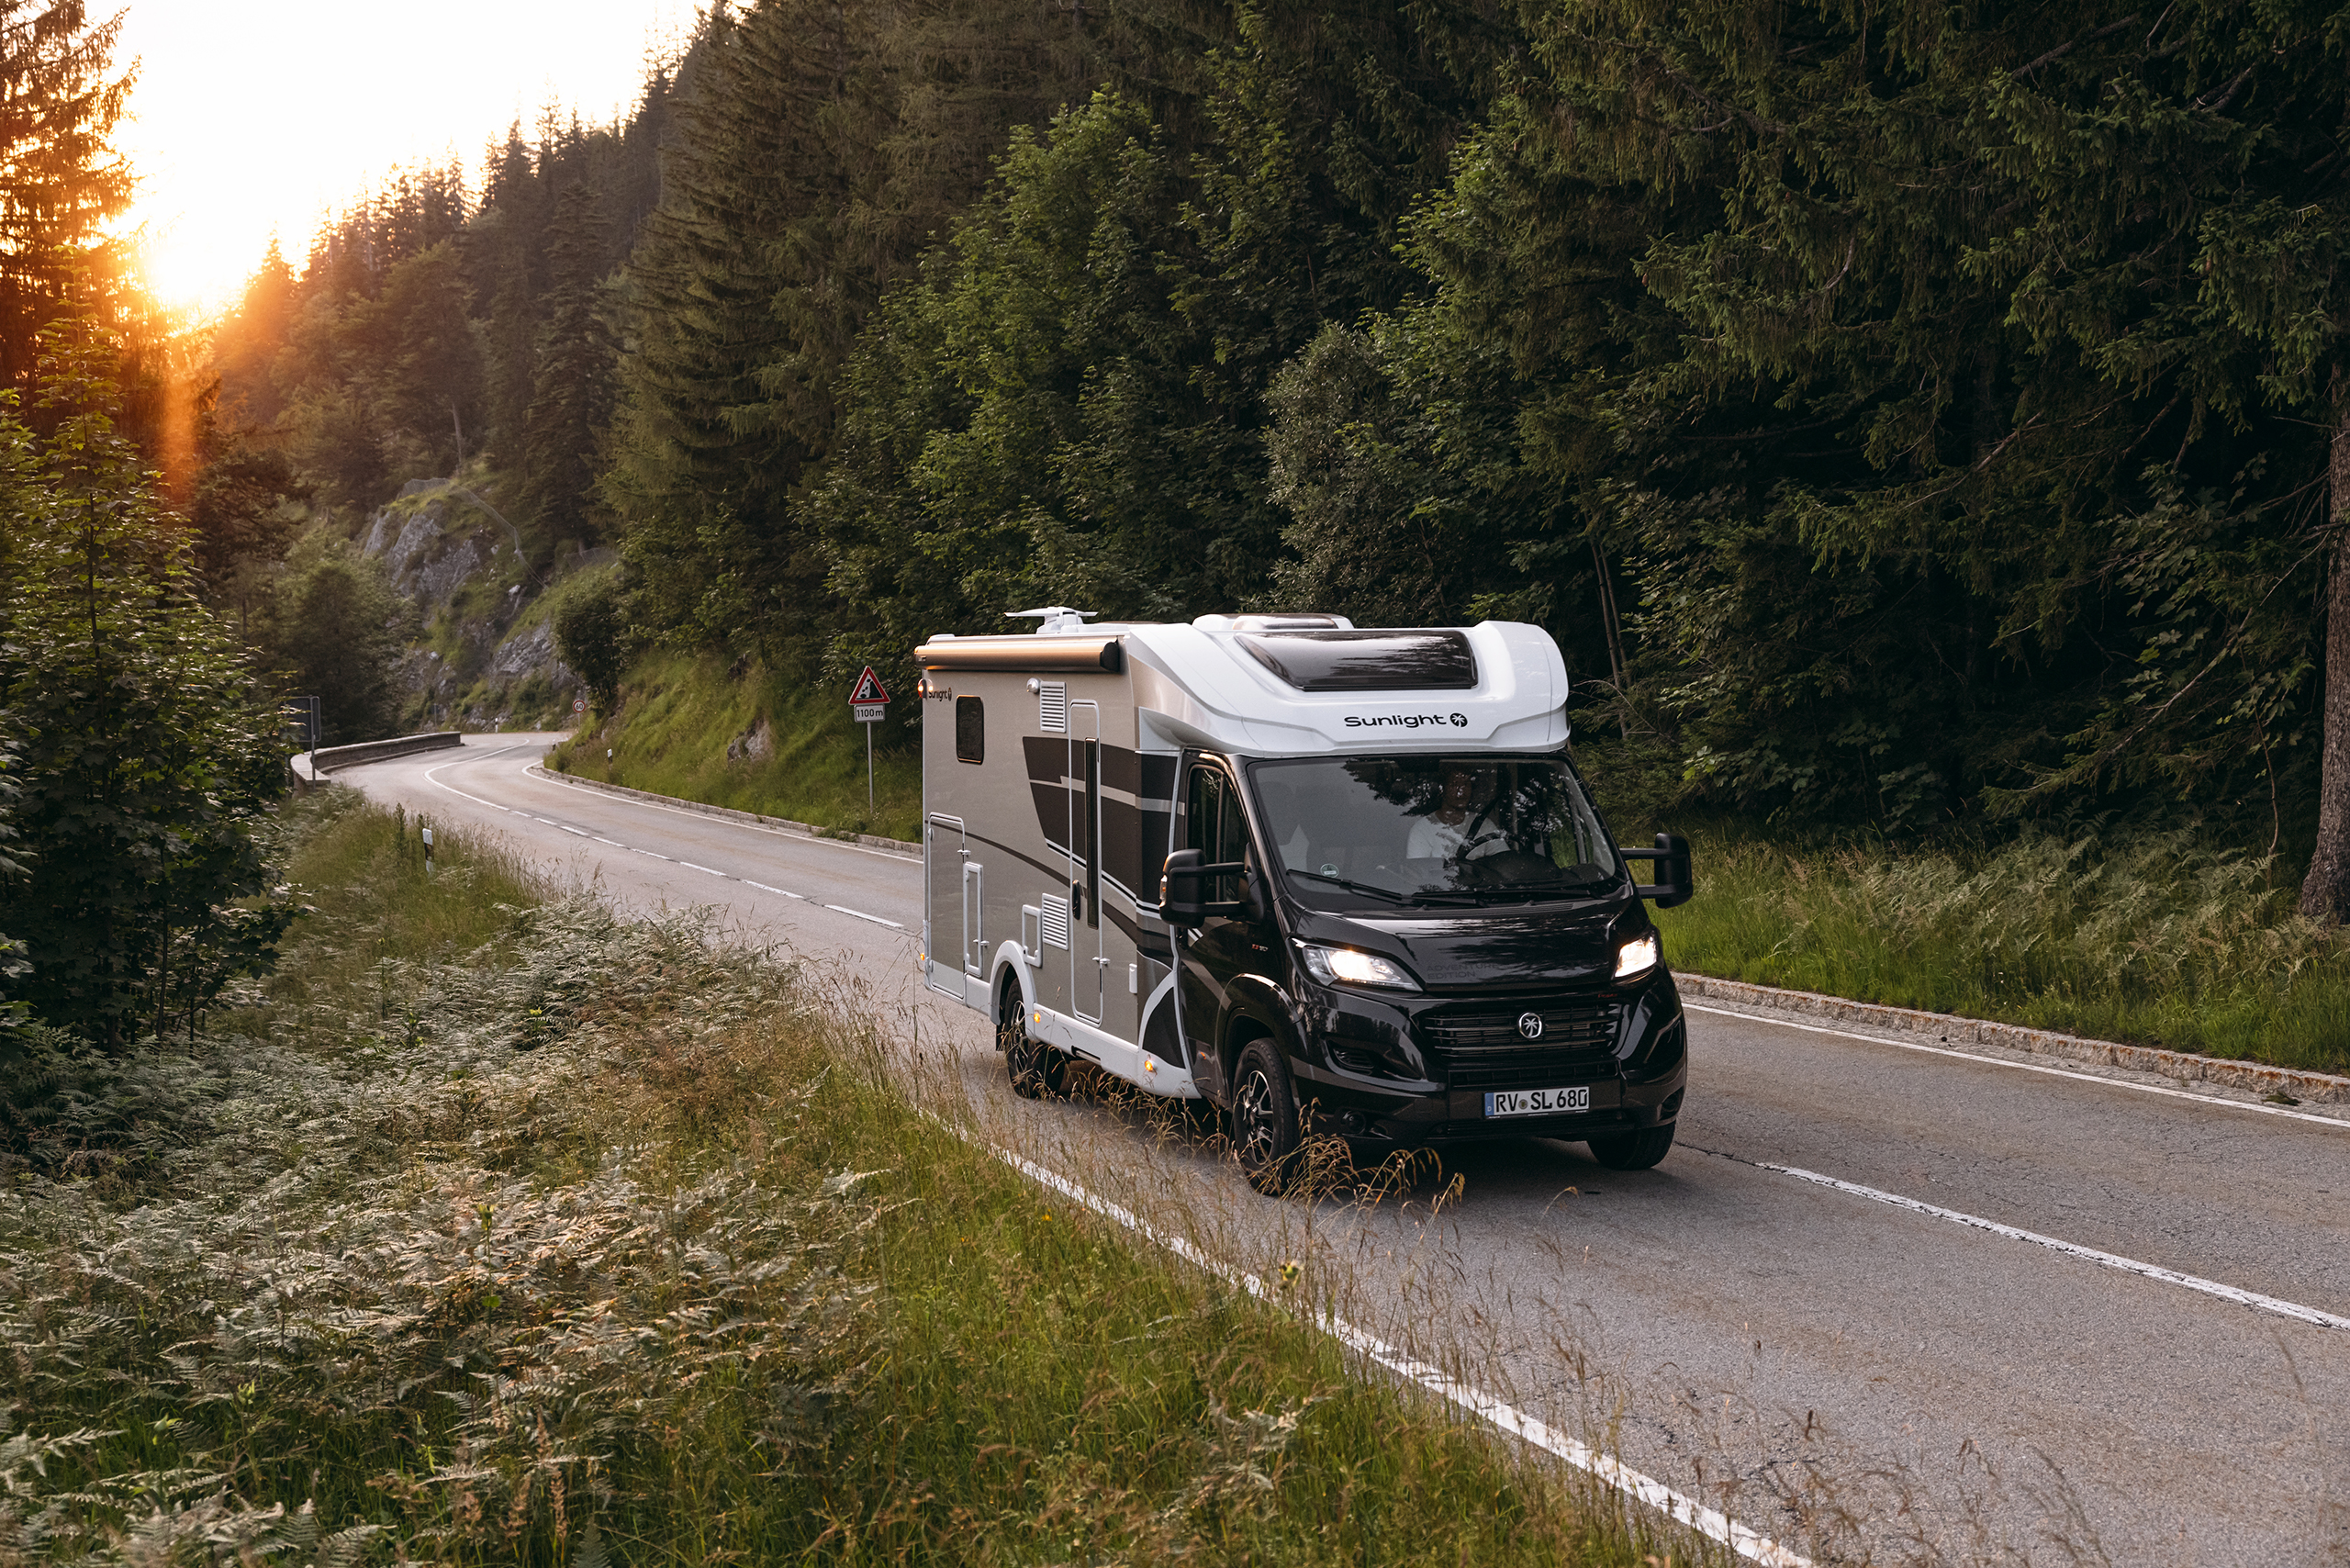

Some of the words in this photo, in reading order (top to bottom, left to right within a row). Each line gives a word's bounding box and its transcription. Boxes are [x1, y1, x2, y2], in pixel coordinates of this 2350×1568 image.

[856, 708, 875, 717] 1100
[1344, 714, 1447, 728] Sunlight
[1427, 963, 1497, 971] ADVENTURE
[1427, 971, 1476, 980] EDITION
[1496, 1093, 1518, 1113] RV
[1530, 1092, 1553, 1111] SL
[1556, 1090, 1587, 1108] 680
